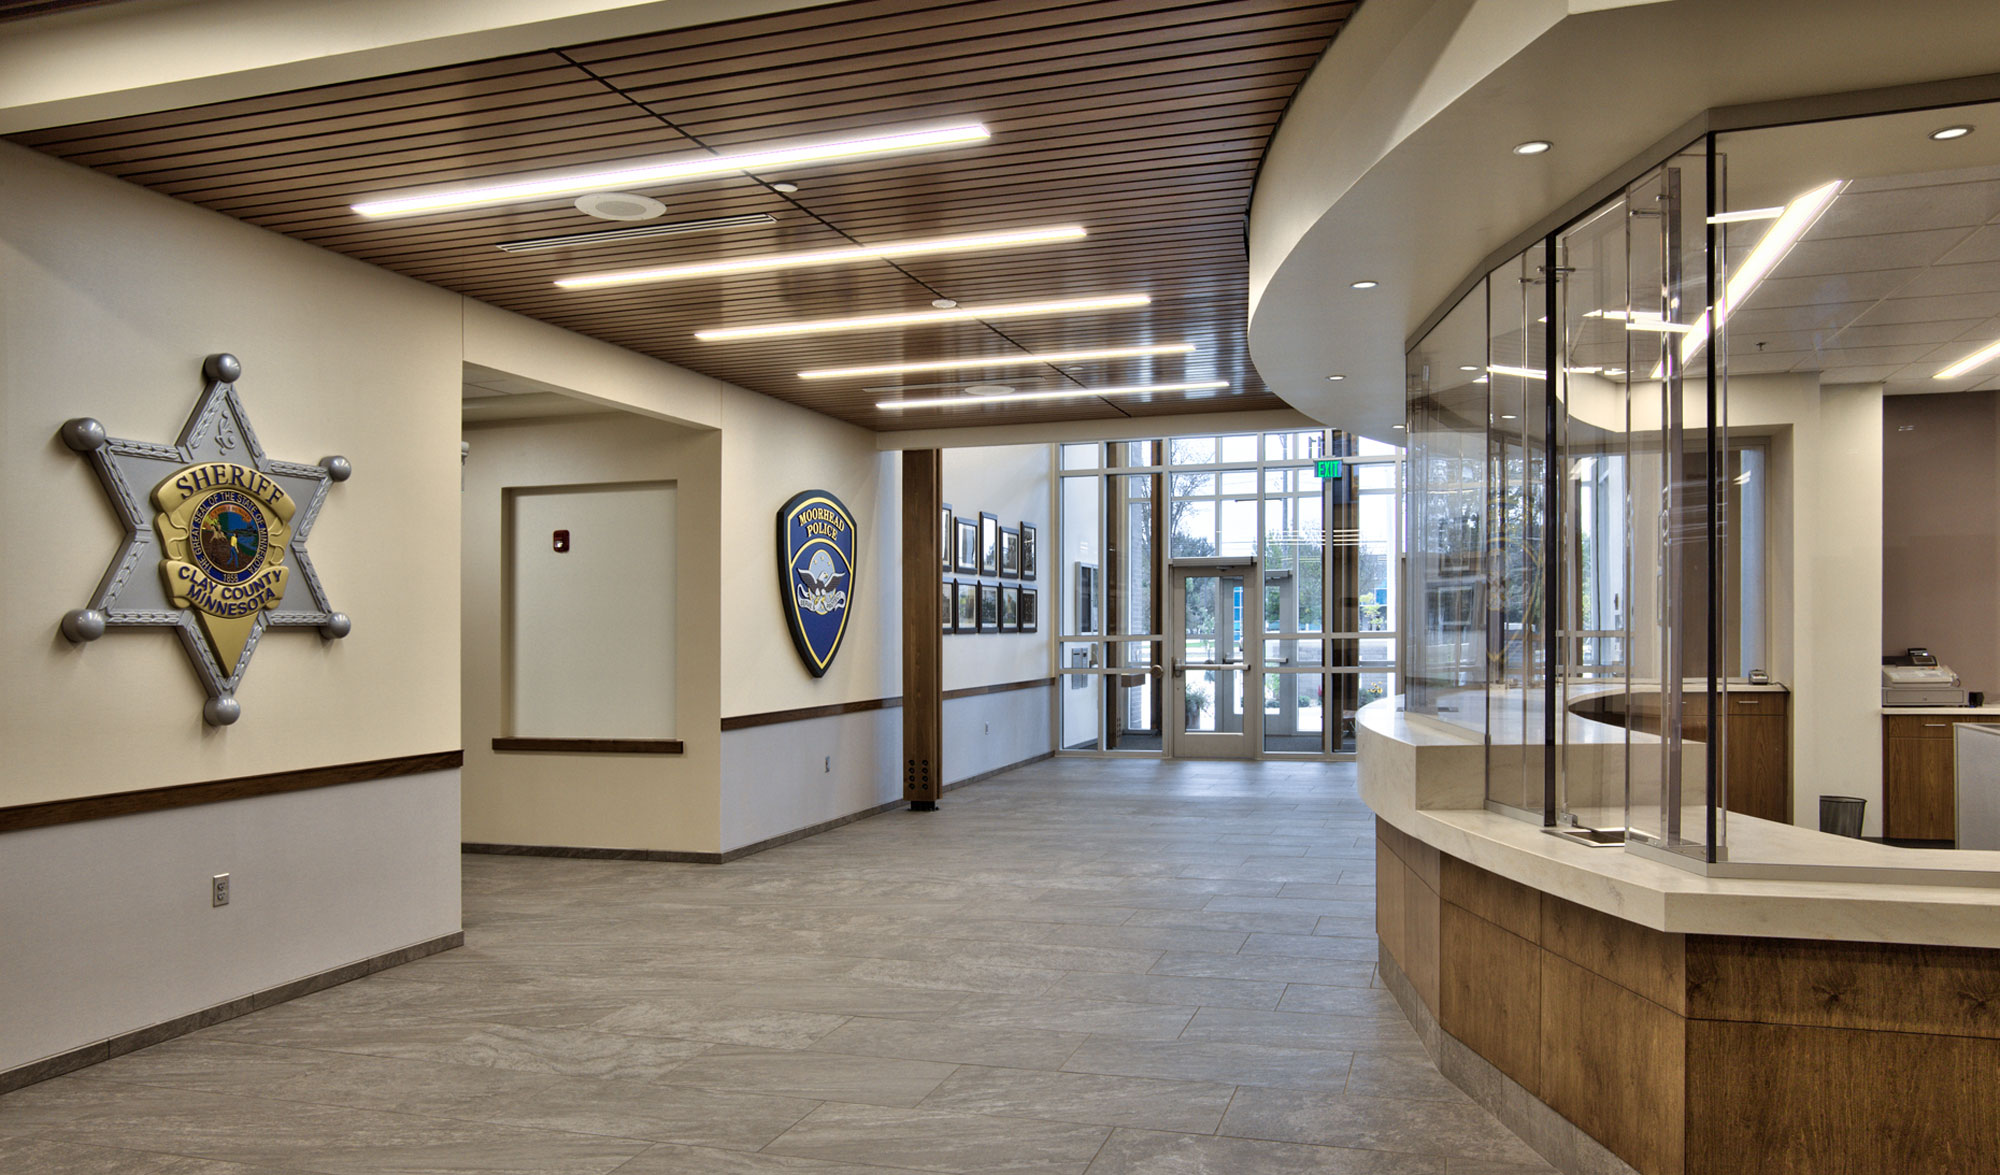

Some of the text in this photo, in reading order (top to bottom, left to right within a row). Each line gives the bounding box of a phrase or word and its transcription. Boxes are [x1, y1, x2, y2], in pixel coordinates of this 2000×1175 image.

[1318, 461, 1339, 477] EXIT
[176, 464, 285, 505] SHERIFF
[208, 494, 218, 505] OF
[221, 492, 235, 500] THE
[237, 495, 257, 514] STATE
[195, 502, 209, 524] SEAL
[255, 513, 264, 526] OF
[798, 508, 844, 531] MOORHEAD
[807, 522, 837, 541] POLICE
[248, 528, 267, 573] MINNESOTA
[179, 566, 282, 600] CLAY COUNTY
[187, 584, 276, 616] MINNESOTA
